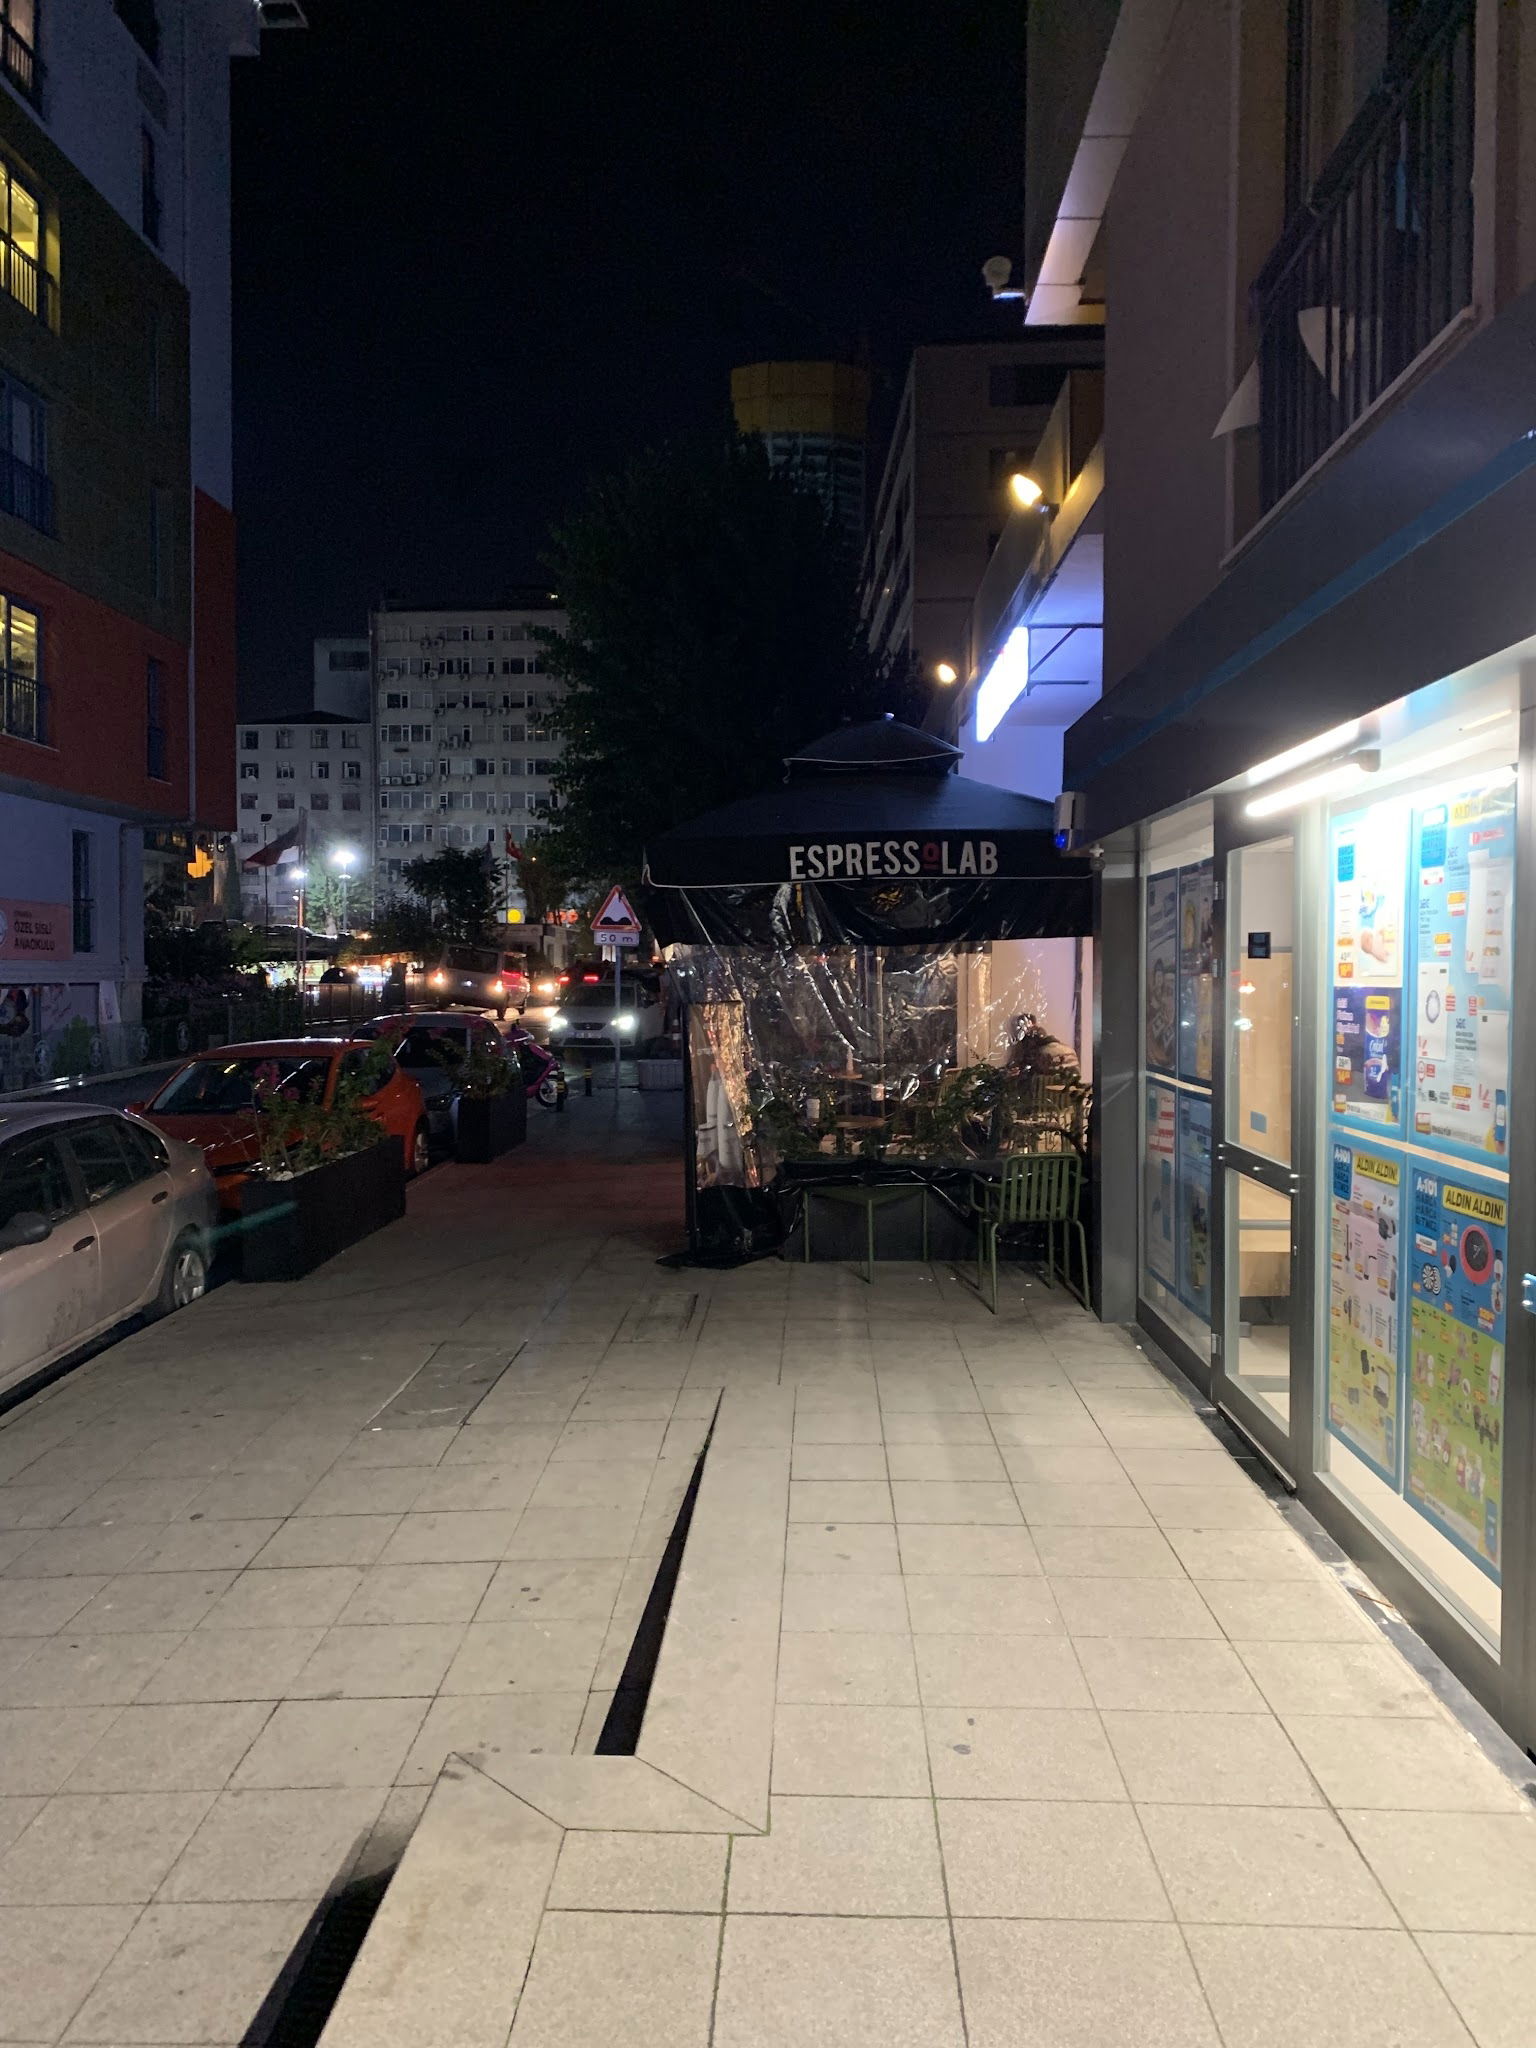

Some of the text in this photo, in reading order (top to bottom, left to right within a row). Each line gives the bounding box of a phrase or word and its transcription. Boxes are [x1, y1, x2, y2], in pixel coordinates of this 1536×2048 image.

[601, 933, 616, 943] 50
[1446, 1190, 1504, 1221] ALDIN ALDIN!
